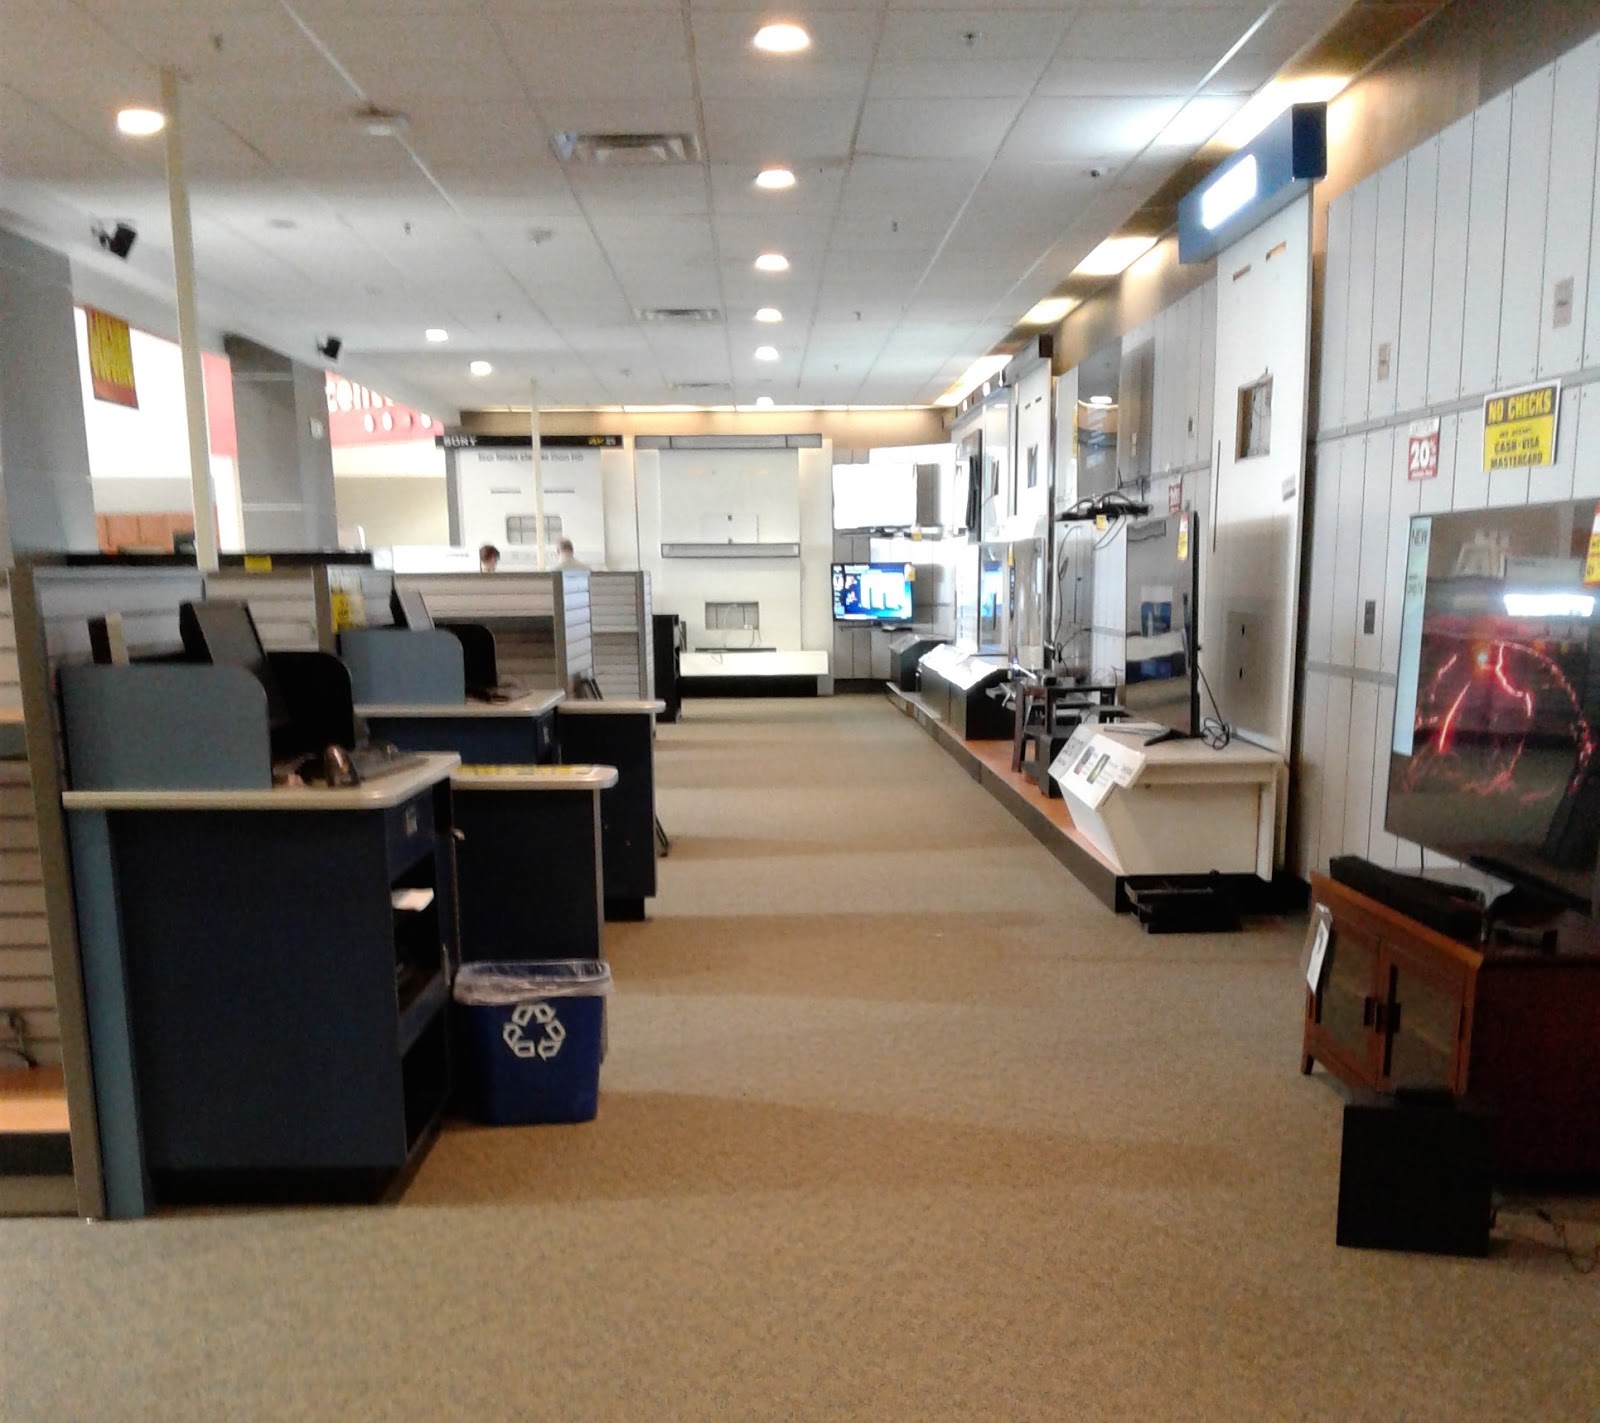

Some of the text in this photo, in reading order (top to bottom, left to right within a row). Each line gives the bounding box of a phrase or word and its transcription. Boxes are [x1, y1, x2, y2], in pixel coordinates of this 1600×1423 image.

[1488, 388, 1552, 424] NO CHECKS
[1490, 452, 1543, 470] MASTERCARD
